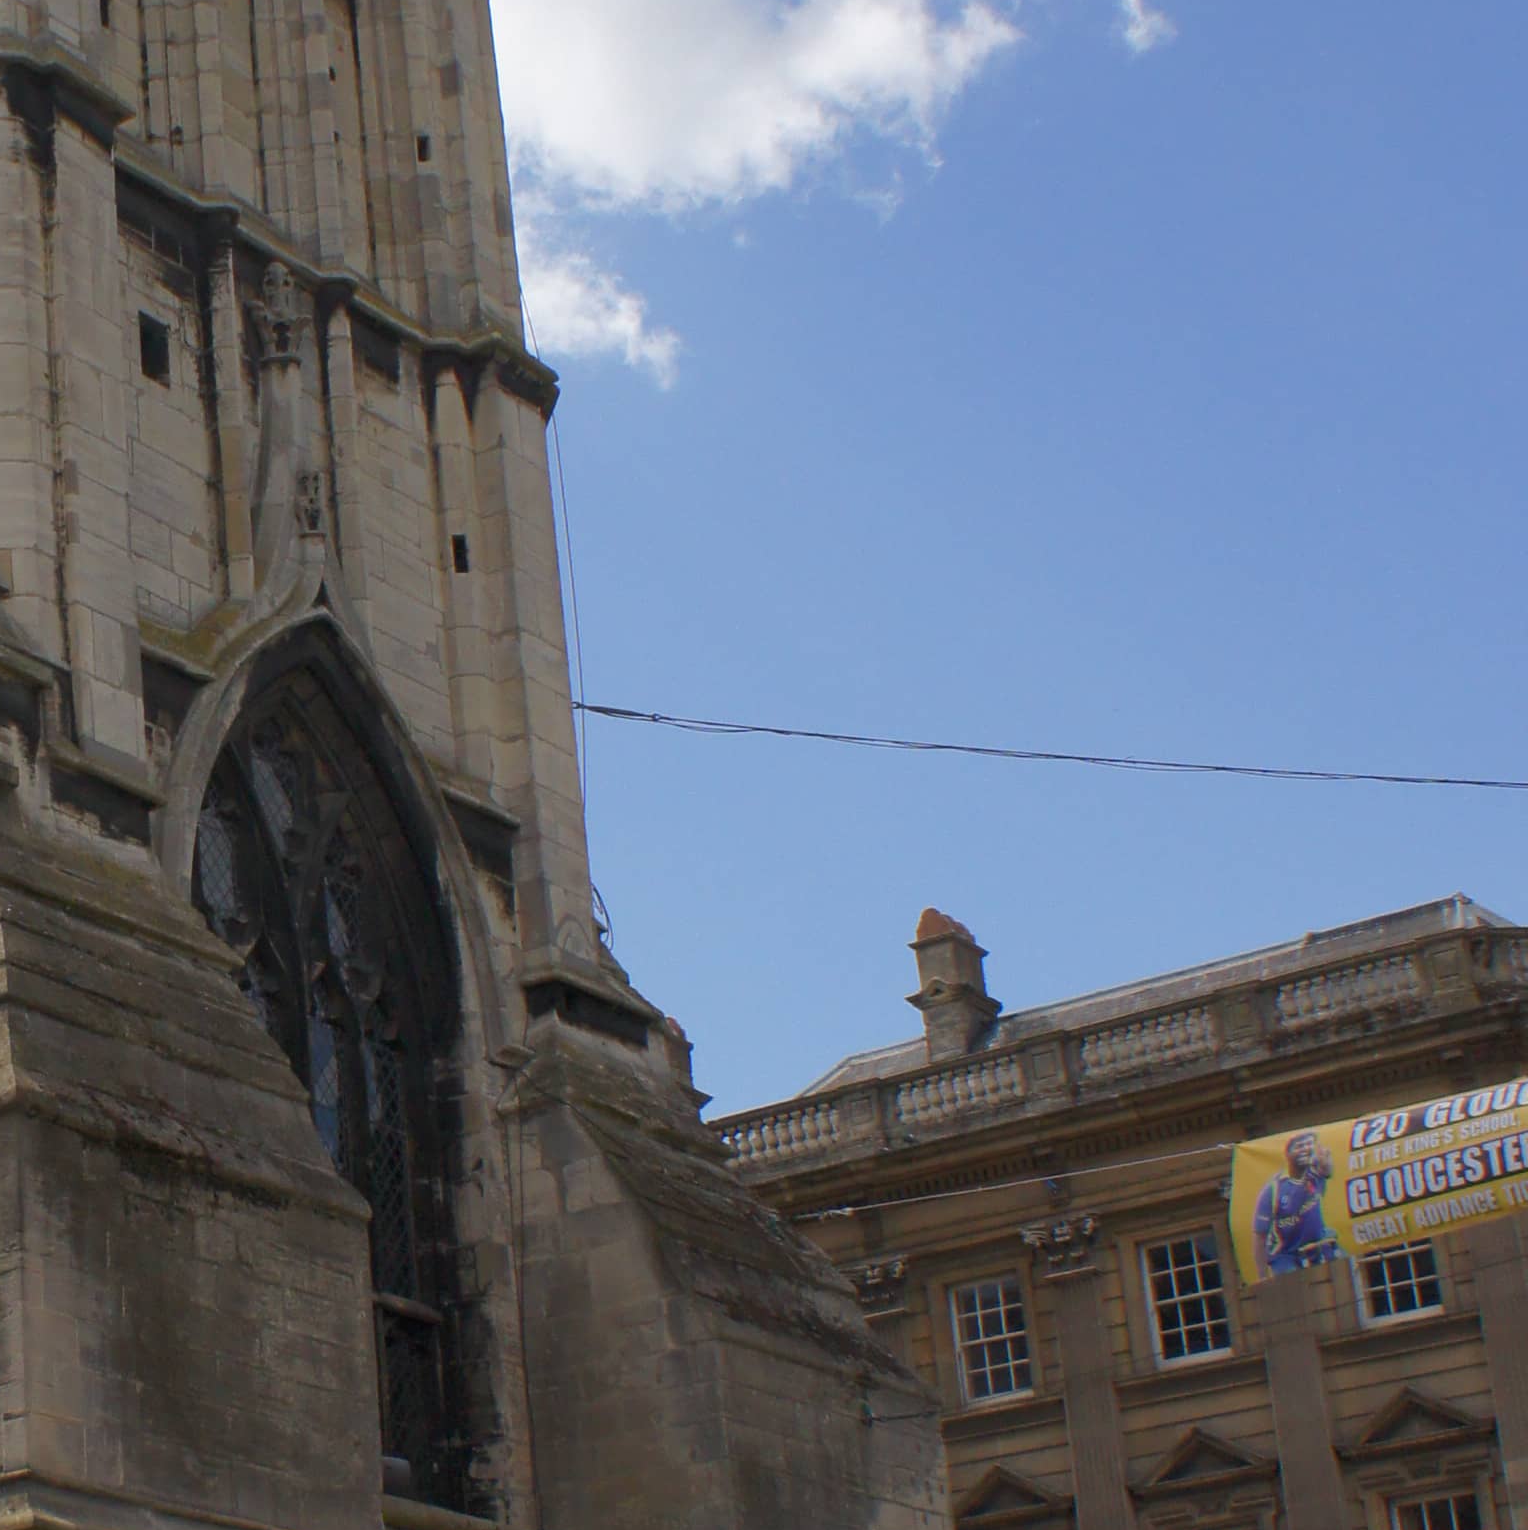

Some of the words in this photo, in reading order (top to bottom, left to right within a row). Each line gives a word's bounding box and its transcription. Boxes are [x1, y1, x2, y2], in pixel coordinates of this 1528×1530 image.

[1348, 1151, 1366, 1171] AT
[1373, 1142, 1400, 1163] THE
[1352, 1210, 1408, 1244] GREAT
[1414, 1187, 1498, 1228] ADVANCE
